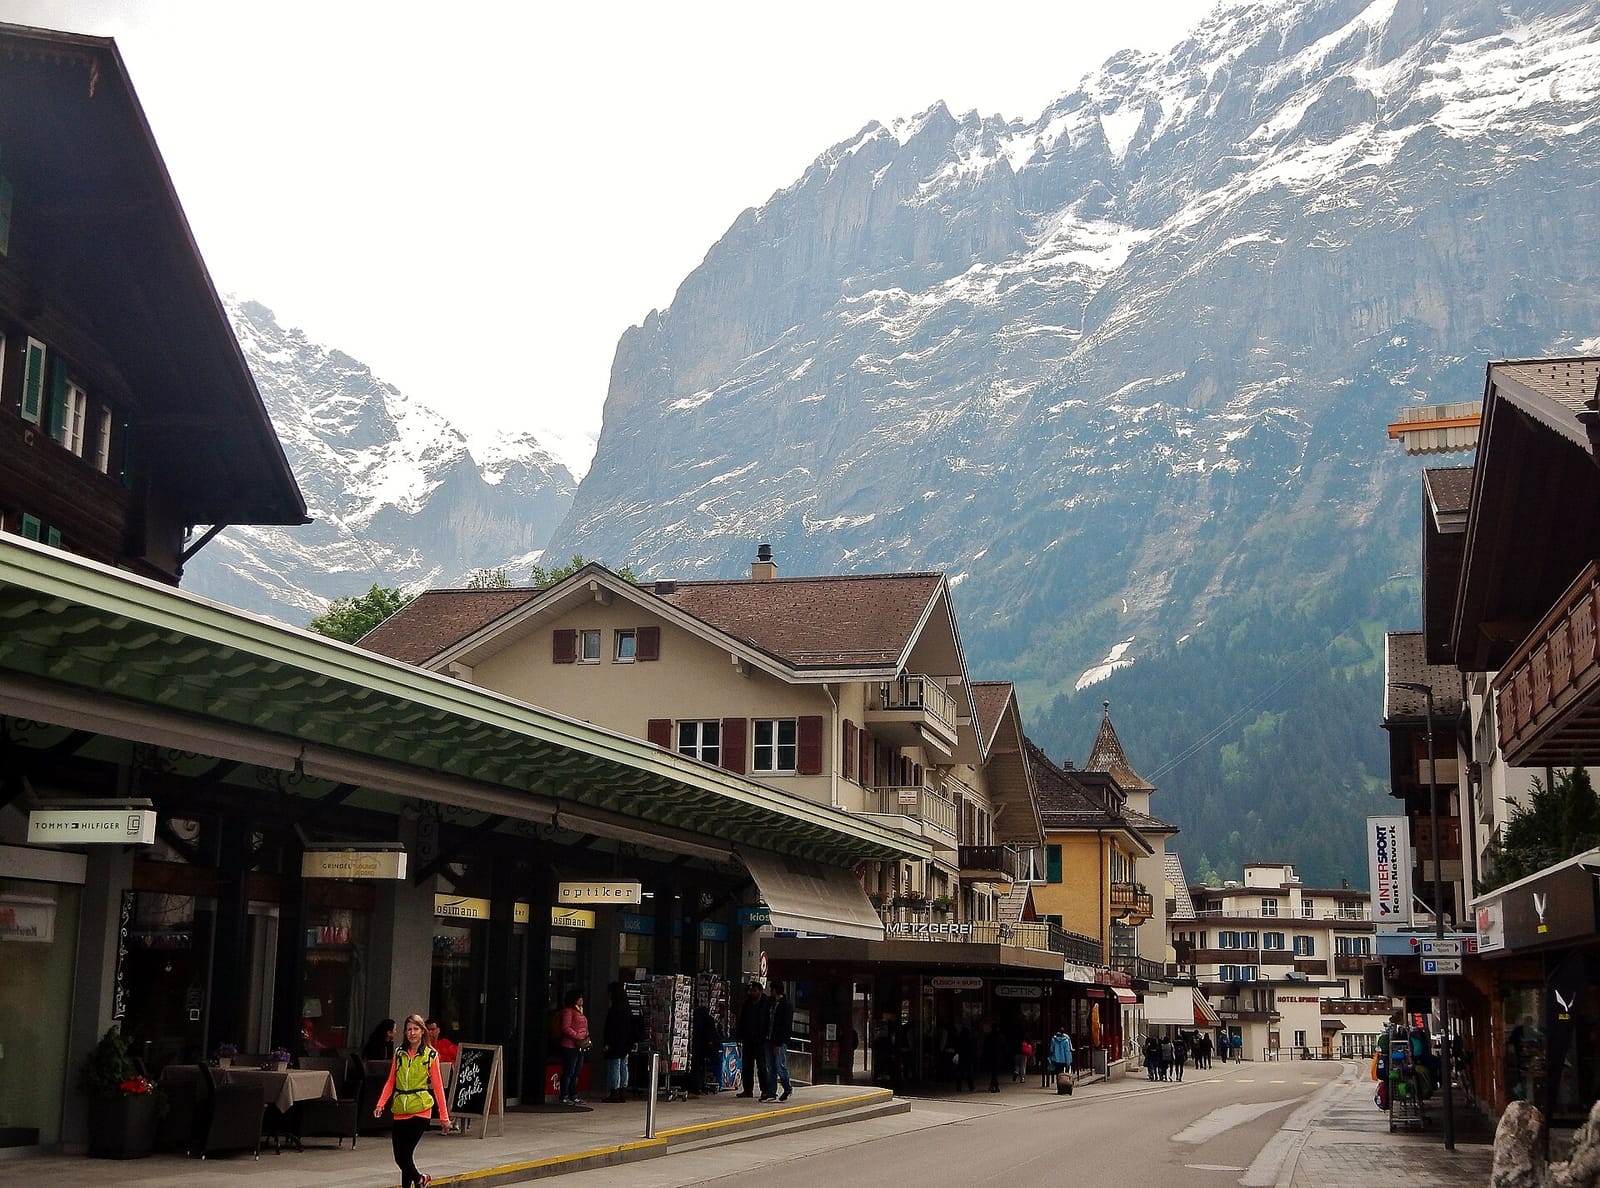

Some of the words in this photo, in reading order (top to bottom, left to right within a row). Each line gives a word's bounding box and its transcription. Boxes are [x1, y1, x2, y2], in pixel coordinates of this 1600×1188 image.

[35, 822, 69, 830] TOMMY
[81, 822, 120, 830] HILFIGER
[1376, 825, 1390, 901] INTERSPORT
[1389, 825, 1400, 914] Rent-Network
[563, 886, 634, 899] optiker
[749, 912, 770, 922] kios
[886, 922, 973, 935] METZGEREI
